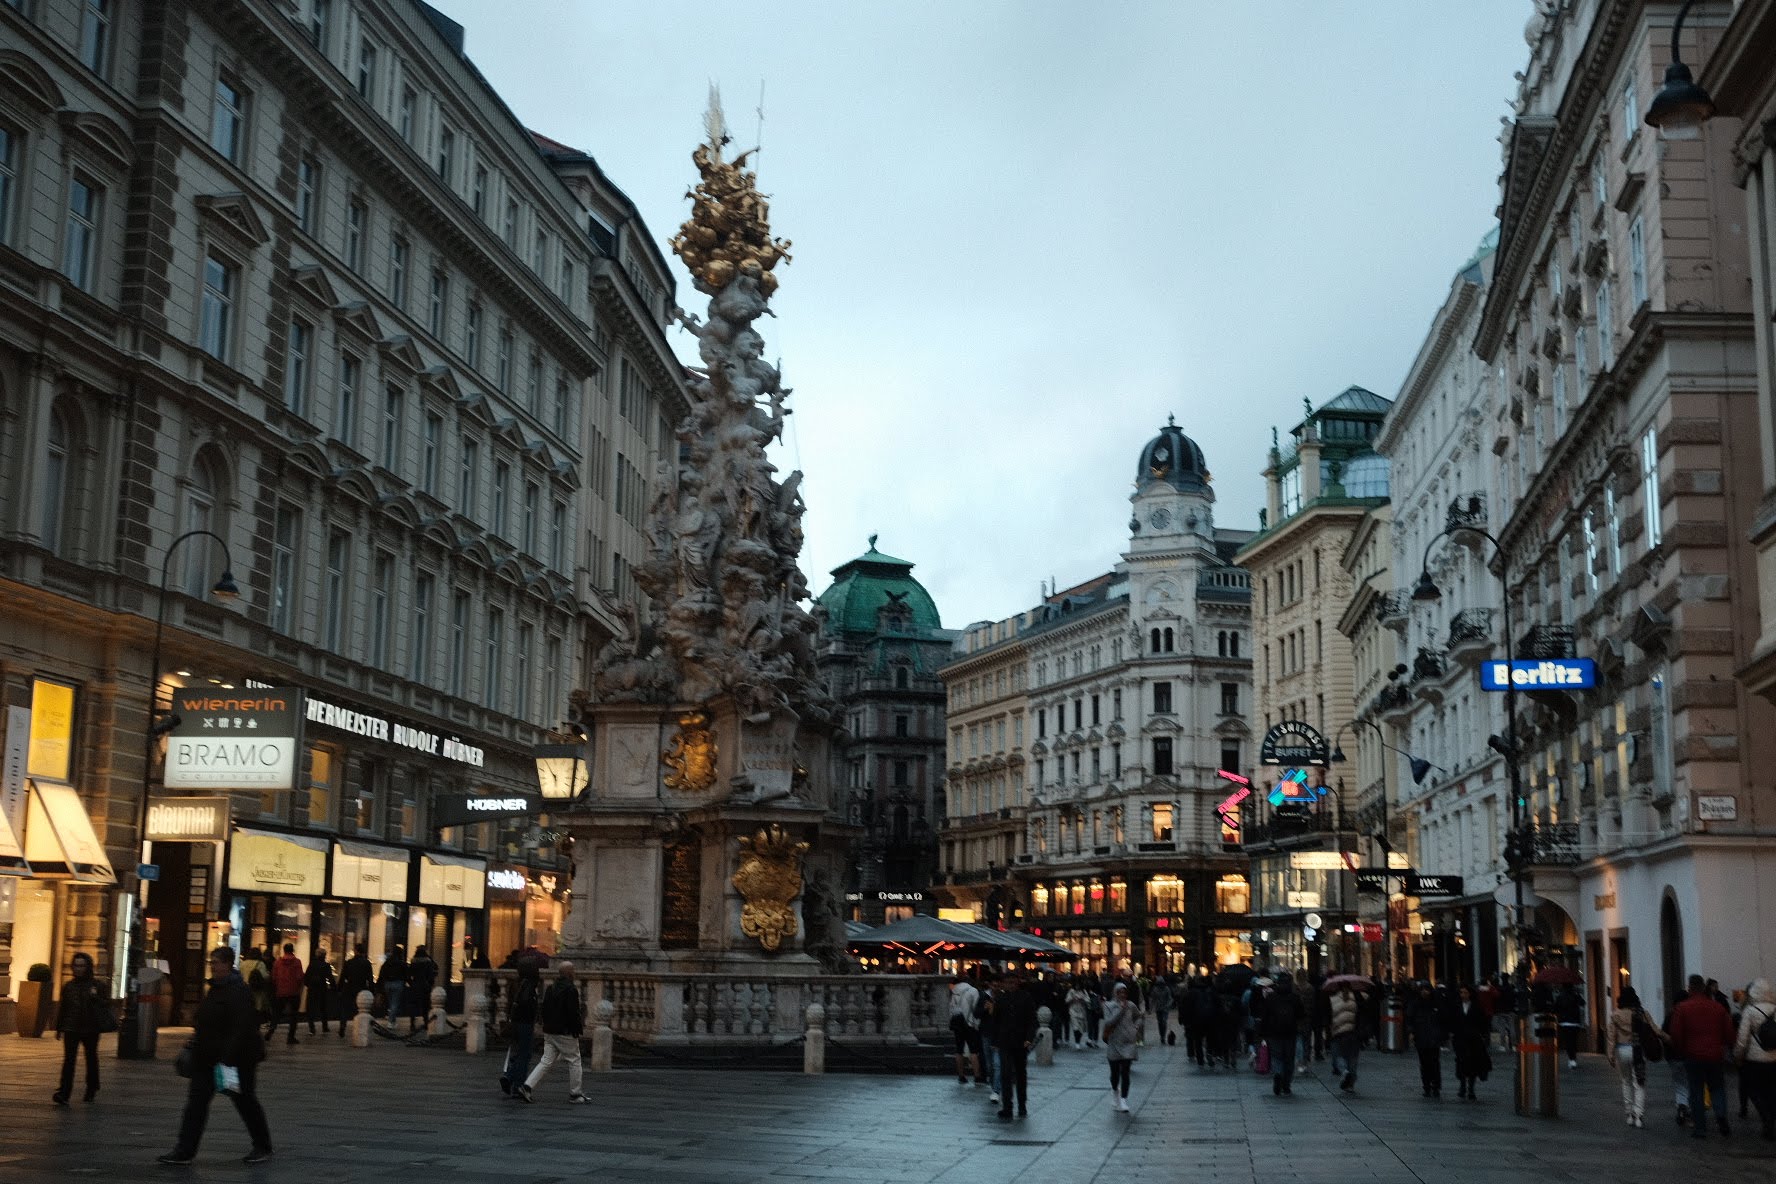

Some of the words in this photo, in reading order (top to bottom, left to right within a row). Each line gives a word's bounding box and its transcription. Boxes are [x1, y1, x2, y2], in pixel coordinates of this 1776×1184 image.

[1494, 662, 1583, 685] Berlitz
[183, 697, 287, 712] wienerin
[305, 698, 389, 742] HERMEISTER
[393, 723, 439, 755] RUDOLF
[442, 736, 484, 768] HÜBNER
[178, 744, 281, 766] BRAMO
[1274, 747, 1313, 758] BUFFET
[1419, 878, 1443, 889] IWC
